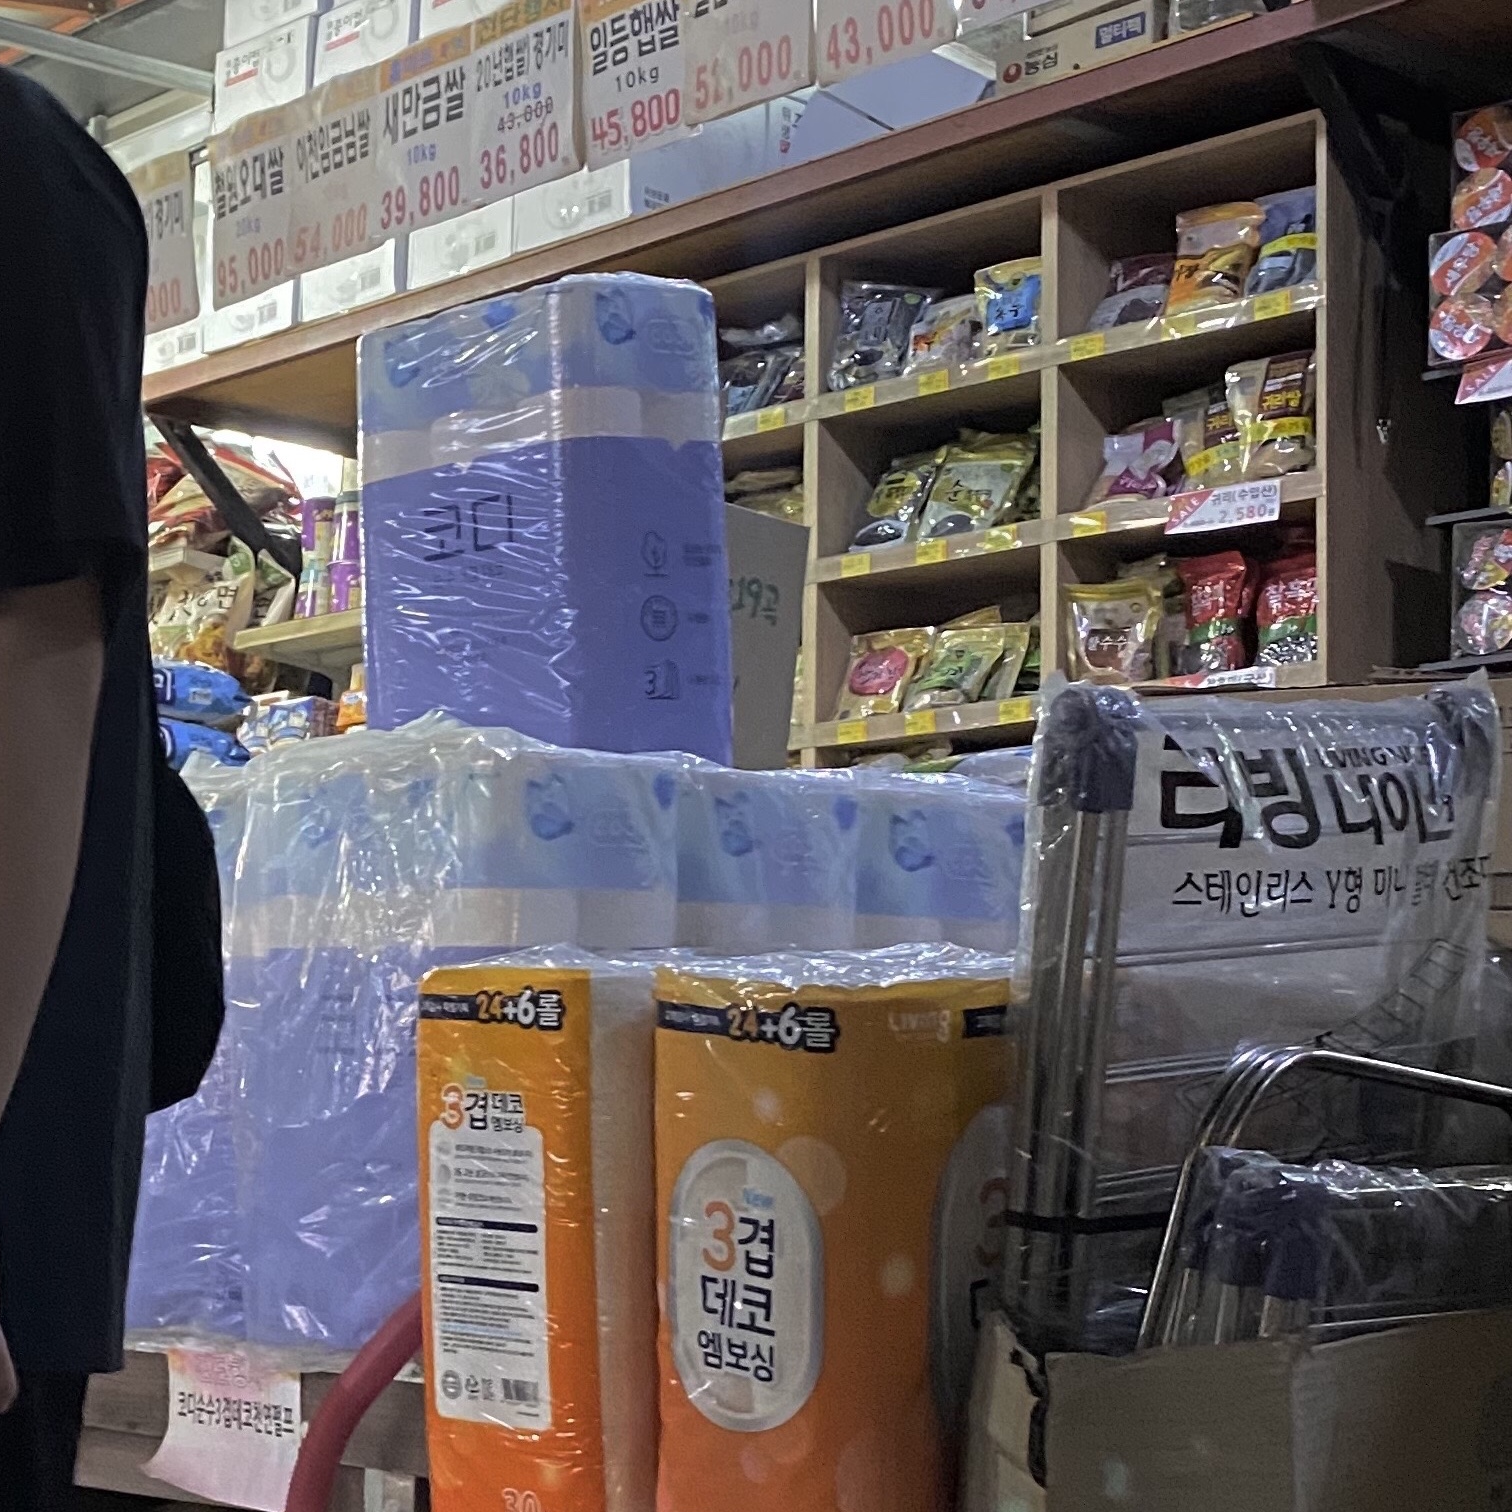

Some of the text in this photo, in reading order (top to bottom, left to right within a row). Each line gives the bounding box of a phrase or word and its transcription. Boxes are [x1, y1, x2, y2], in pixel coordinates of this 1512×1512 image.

[590, 1, 679, 75] 일등햅쌀
[827, 0, 934, 69] 43,000
[383, 66, 466, 145] 새만금쌀
[615, 66, 659, 92] 10kg
[591, 88, 680, 149] 45,800
[480, 121, 559, 189] 36,800
[381, 165, 460, 230] 39,800
[294, 202, 368, 264] 54,000
[217, 237, 285, 298] 95,000
[1172, 869, 1314, 917] 스테인리스
[1325, 866, 1362, 913] Y형
[476, 985, 563, 1028] 24+6롤
[728, 1002, 837, 1052] 24+6롤
[702, 1201, 775, 1280] 3겹
[700, 1274, 776, 1338] 데코
[697, 1329, 775, 1383] 엠보싱
